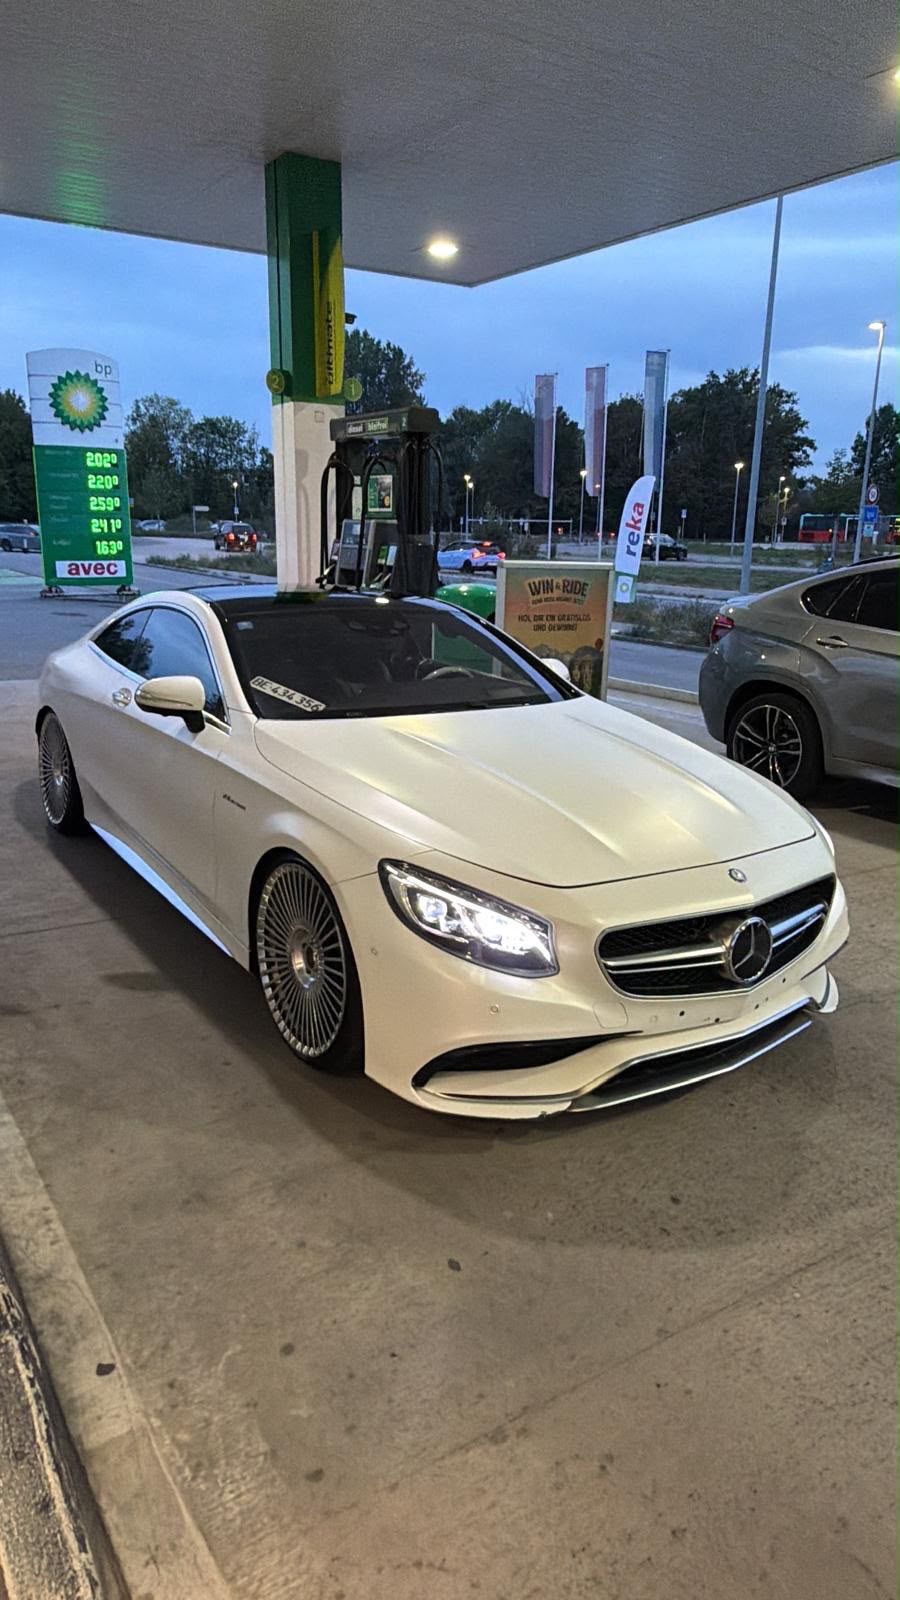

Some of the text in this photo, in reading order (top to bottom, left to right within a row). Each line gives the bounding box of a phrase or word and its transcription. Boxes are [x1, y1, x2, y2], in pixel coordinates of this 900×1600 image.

[94, 360, 112, 377] bp
[625, 502, 645, 557] reka
[67, 562, 119, 577] avec
[528, 578, 554, 596] WIN
[561, 578, 590, 597] RIDE
